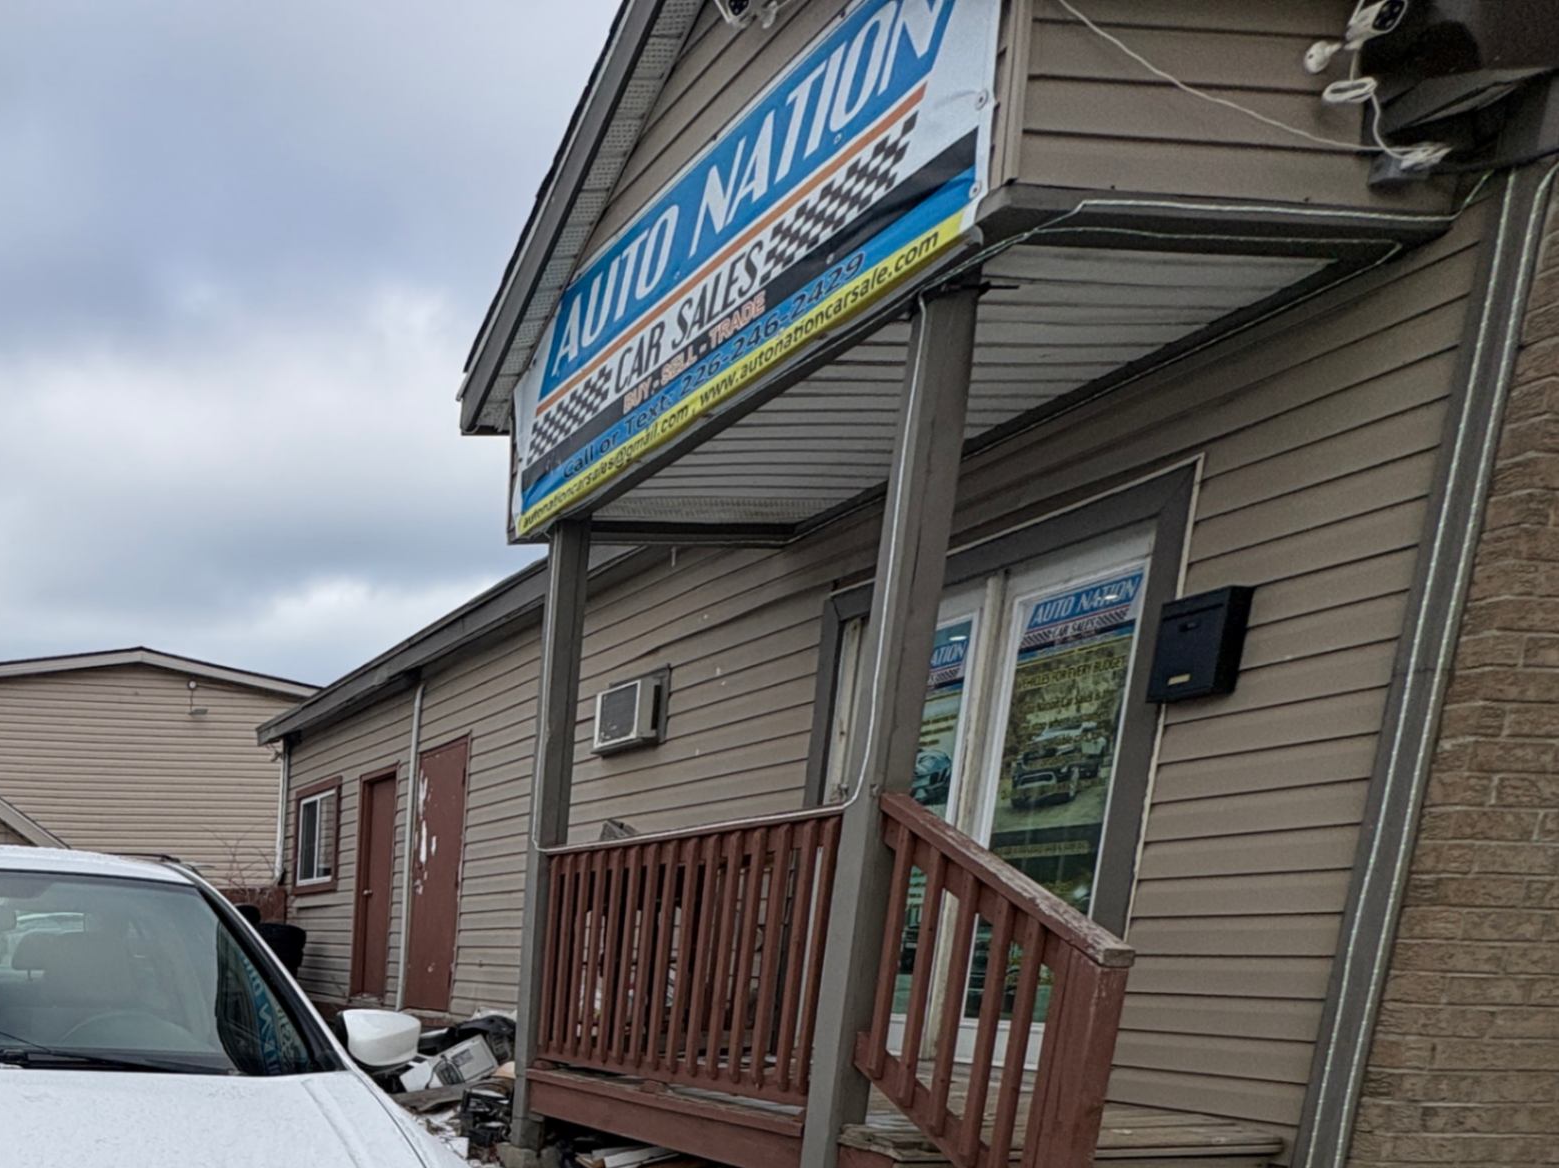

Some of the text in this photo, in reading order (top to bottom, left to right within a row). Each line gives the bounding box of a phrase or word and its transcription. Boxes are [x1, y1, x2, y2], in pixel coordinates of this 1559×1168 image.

[551, 0, 943, 378] AUTO NATION
[562, 444, 594, 479] Call
[600, 430, 621, 455] or
[680, 251, 866, 396] 226-246-2429
[614, 239, 764, 394] CAR SALES
[622, 376, 652, 415] BUY
[708, 289, 767, 349] TRADE
[698, 230, 940, 407] www.autonationcarsale.com
[930, 641, 967, 667] ATION
[1030, 597, 1076, 626] AUTO
